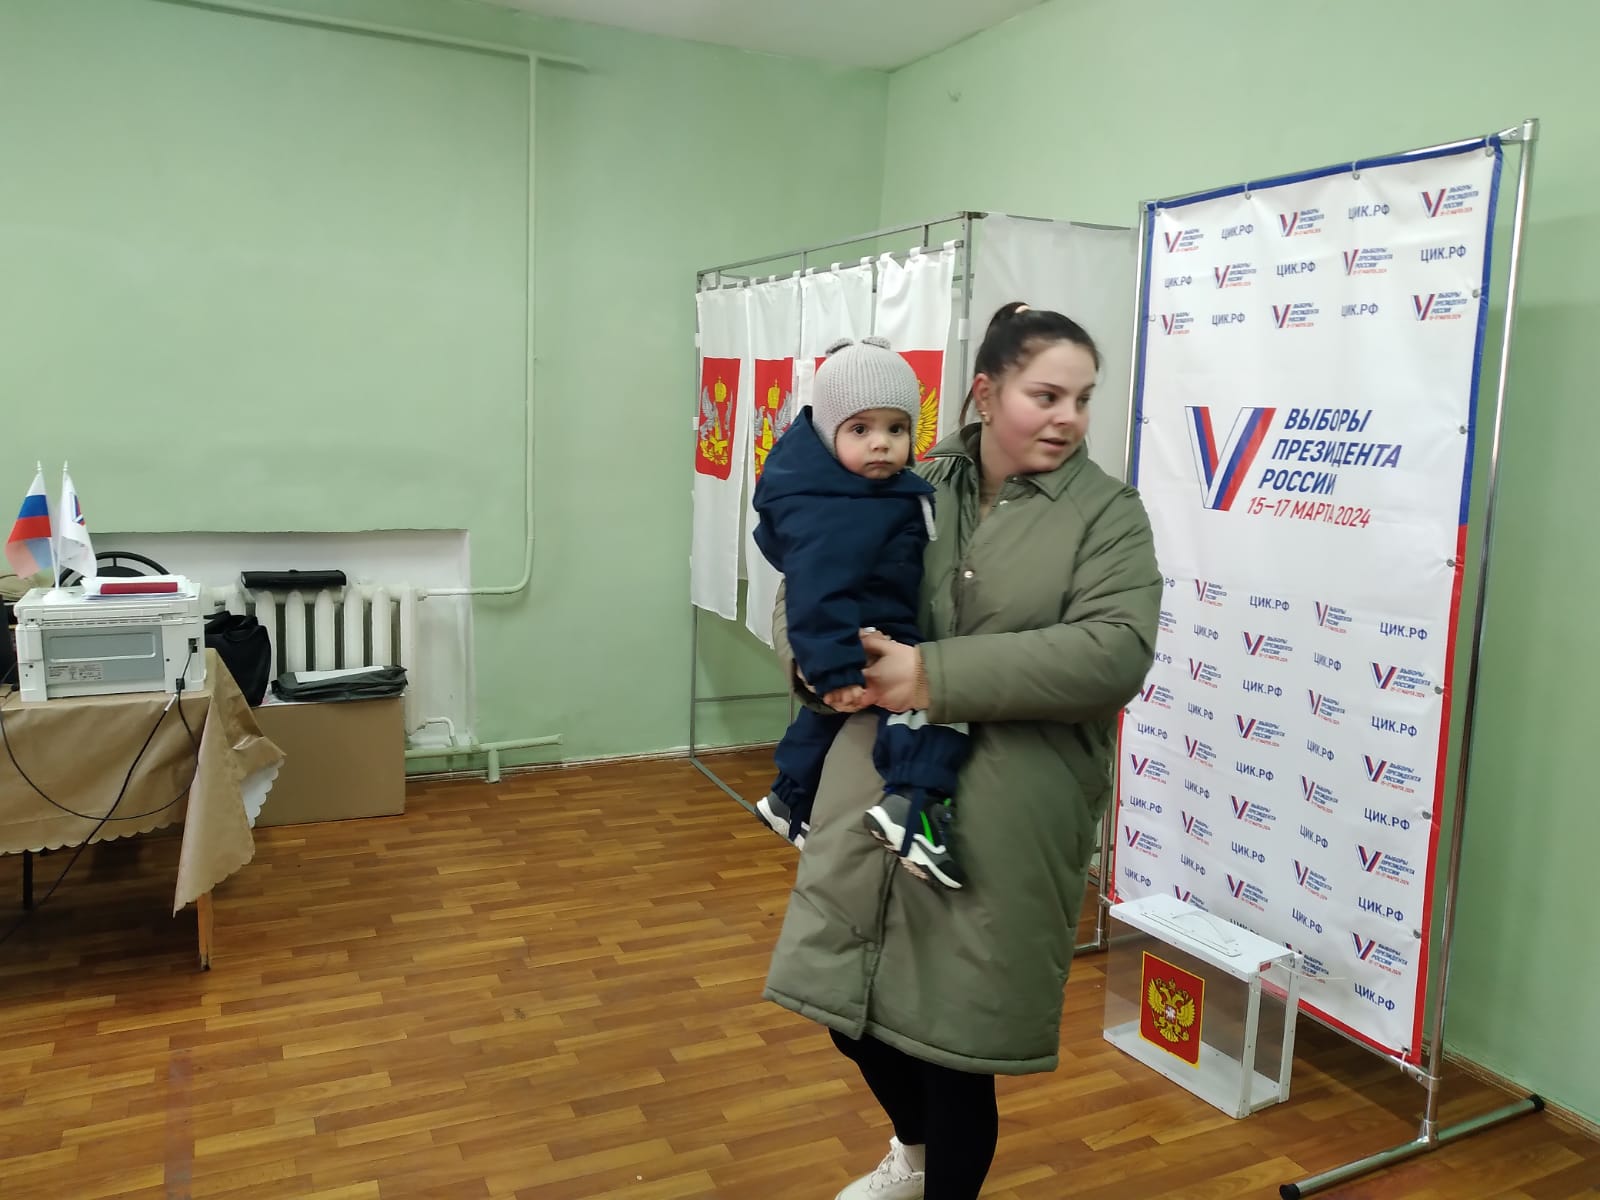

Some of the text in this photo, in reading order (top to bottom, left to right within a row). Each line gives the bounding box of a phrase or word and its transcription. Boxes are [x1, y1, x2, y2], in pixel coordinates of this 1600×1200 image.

[1348, 204, 1391, 220] ЦИК.РФ
[1420, 245, 1467, 263] ЦИК.РФ
[1276, 261, 1316, 277] ЦИК.РФ
[1212, 312, 1245, 326] ЦИК.РФ
[1284, 408, 1373, 432] ВЫБОРЫ
[1272, 439, 1403, 468] ПРЕЗИДЕНТА
[1258, 468, 1338, 496] РОССИИ
[1290, 500, 1334, 524] МАРТА
[1334, 505, 1372, 528] 2024
[1250, 595, 1290, 611] ЦИК.РФ
[1380, 621, 1428, 640] ЦИК.РФ
[1243, 679, 1283, 697] ЦИК.РФ
[1137, 722, 1168, 740] ЦИК.РФ
[1371, 715, 1418, 737] ЦИК.РФ
[1235, 760, 1275, 781] ЦИК.РФ
[1184, 778, 1210, 799] ЦИК.РФ
[1130, 795, 1163, 814] ЦИК.РФ
[1364, 808, 1411, 830] ЦИК.РФ
[1300, 824, 1329, 848] ЦИК.РФ
[1231, 841, 1266, 863] ЦИК.РФ
[1181, 853, 1206, 875] ЦИК.РФ
[1125, 866, 1151, 887] ЦИК.РФ
[1358, 896, 1404, 922] ЦИК.РФ
[1291, 908, 1324, 934] ЦИК.РФ
[1354, 983, 1395, 1011] ЦИК.РФ
